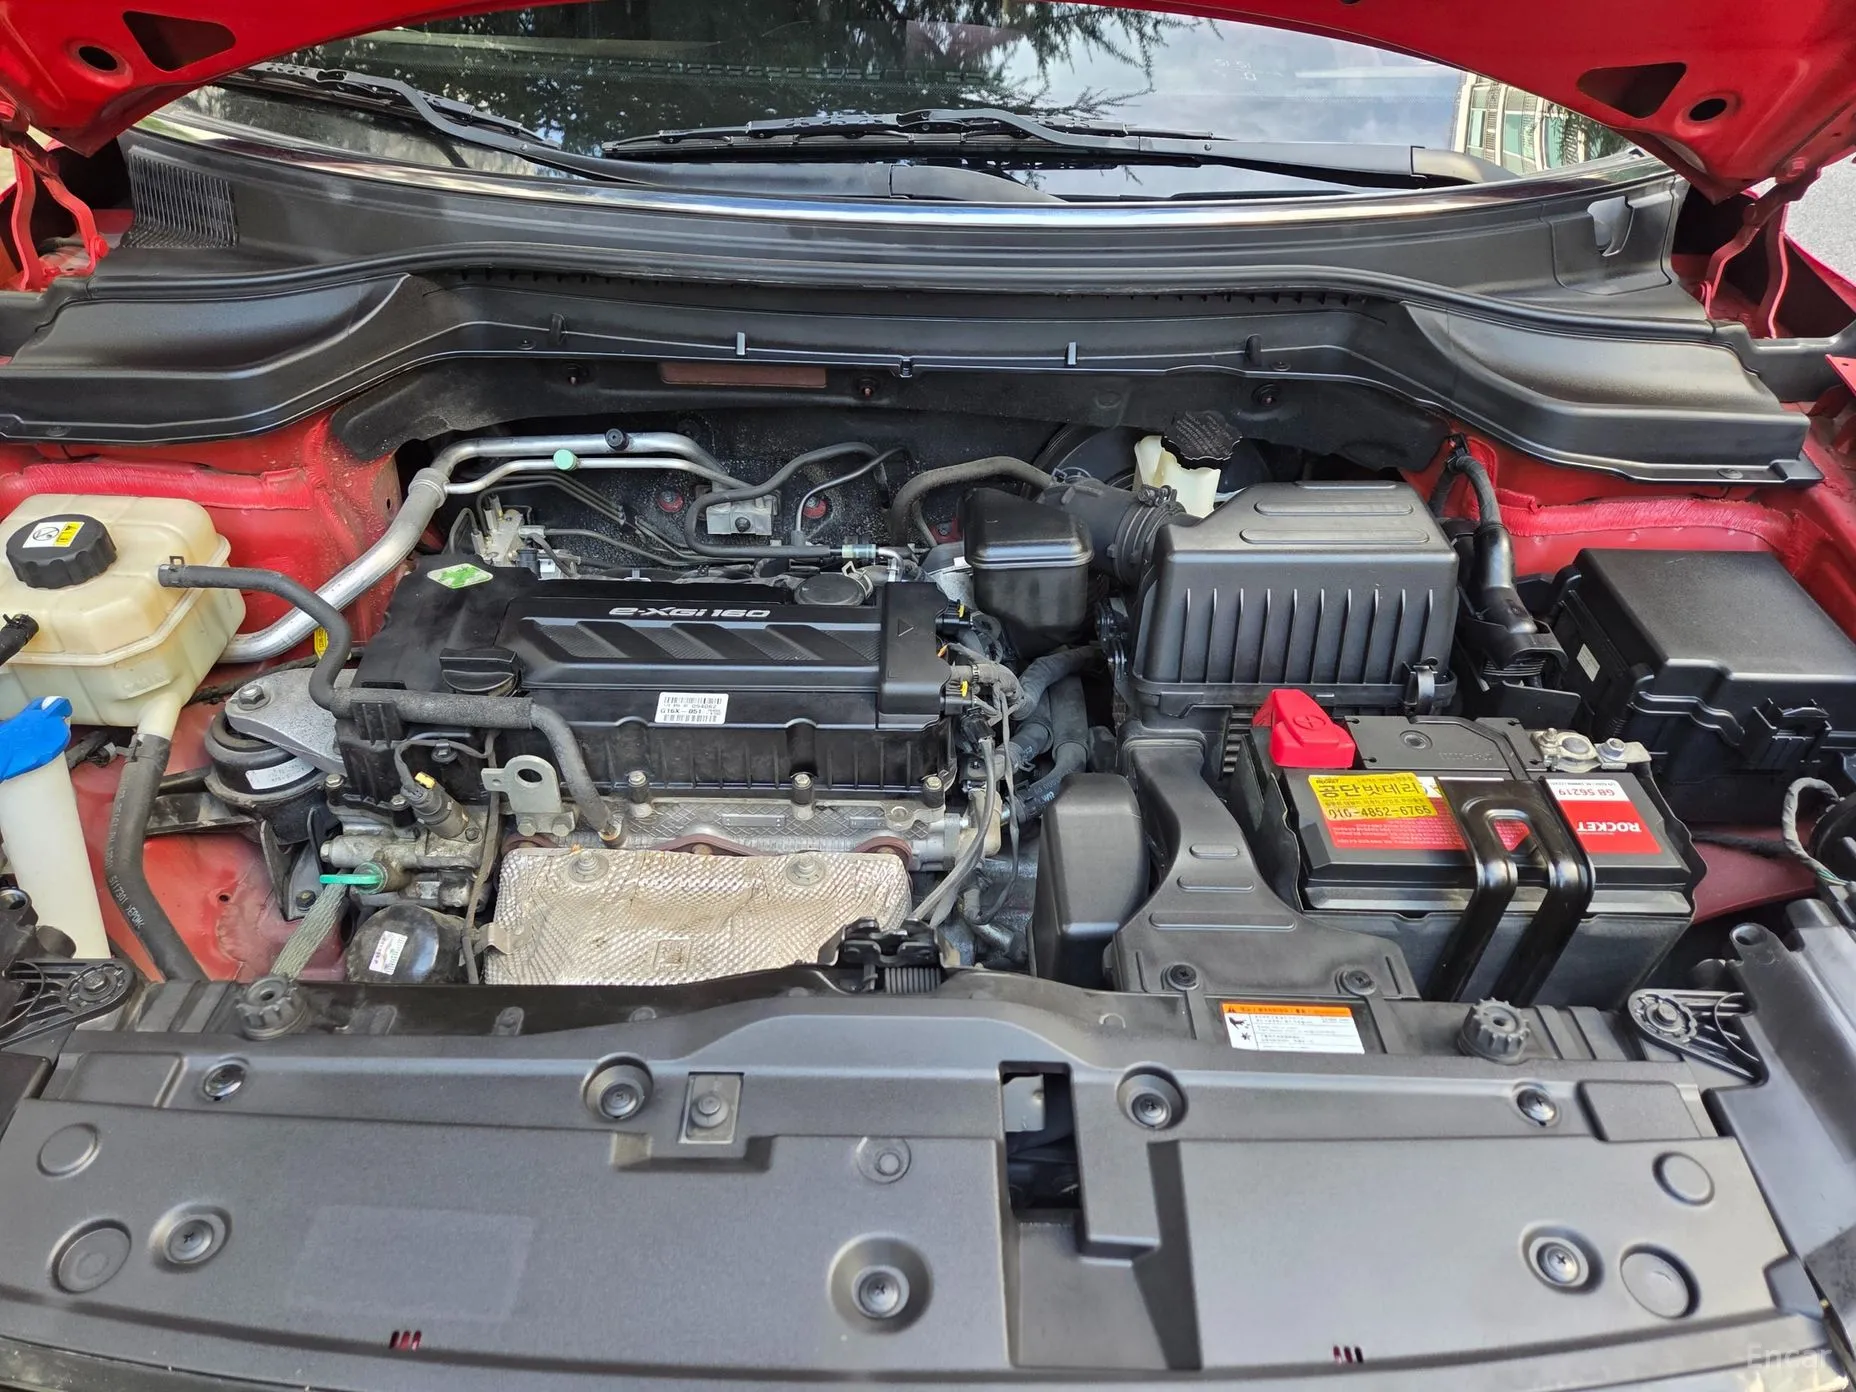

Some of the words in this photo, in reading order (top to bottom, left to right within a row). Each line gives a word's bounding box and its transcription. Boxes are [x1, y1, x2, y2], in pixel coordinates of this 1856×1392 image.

[608, 606, 708, 617] e-XGi
[711, 609, 771, 618] 160
[1558, 788, 1596, 796] 56219
[1597, 788, 1616, 797] GB
[1576, 821, 1642, 833] ROCKET
